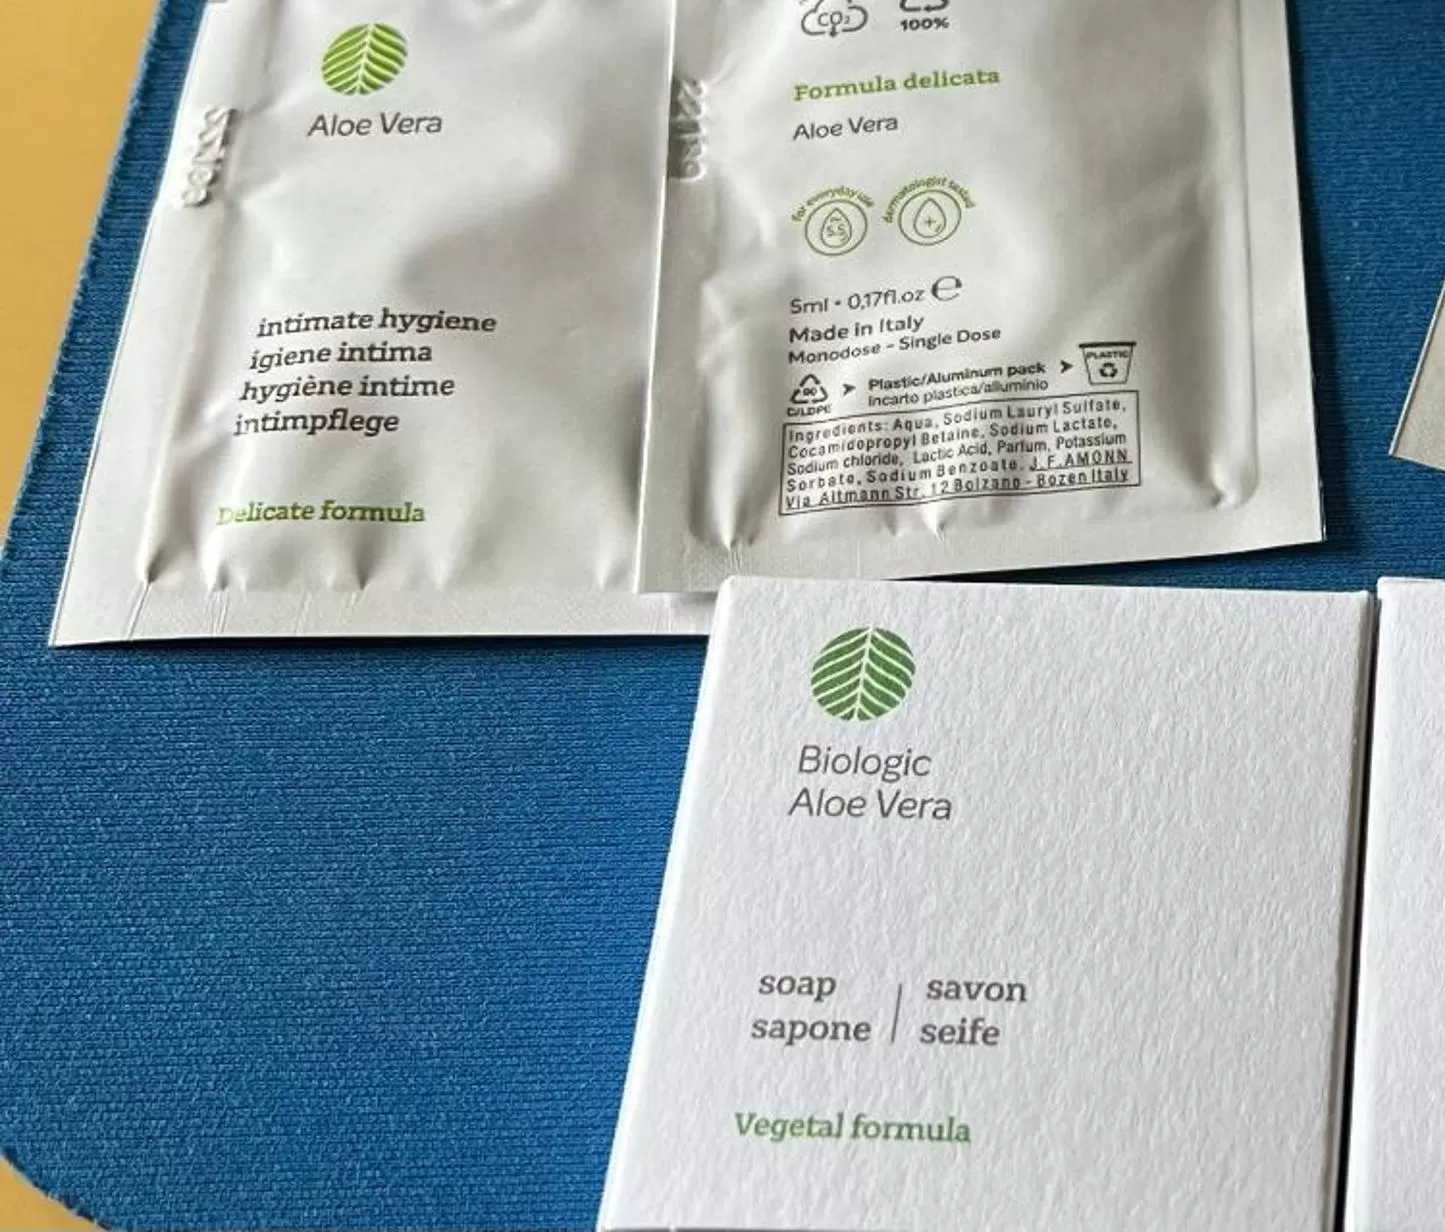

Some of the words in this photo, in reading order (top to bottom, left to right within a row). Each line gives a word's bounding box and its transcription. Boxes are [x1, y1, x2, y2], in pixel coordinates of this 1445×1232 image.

[900, 16, 950, 32] 100%
[792, 74, 897, 102] Formula
[903, 68, 1001, 92] delicata
[307, 114, 374, 138] Aloe
[379, 111, 443, 135] Vera
[792, 122, 843, 142] Aloe
[848, 115, 899, 135] Vera
[789, 298, 828, 315] 5ml
[256, 311, 374, 338] intimate
[376, 308, 497, 334] hygiene
[788, 327, 849, 345] Made
[854, 322, 873, 337] in
[879, 315, 925, 335] Italy
[249, 345, 331, 374] igiene
[336, 341, 433, 363] intima
[788, 342, 881, 365] Monodose
[899, 332, 952, 352] Single
[956, 327, 1001, 343] Dose
[239, 374, 353, 405] hygiène
[357, 376, 456, 398] intime
[868, 366, 1004, 392] Plastic/Aluminum
[1007, 362, 1046, 377] pack
[924, 378, 1049, 405] plastica/alluminio
[234, 408, 400, 437] intimpflege
[943, 406, 1003, 426] Sodium
[1007, 404, 1059, 419] Lauryl
[787, 459, 839, 476] Sodium
[913, 448, 954, 465] Lactic
[1056, 433, 1126, 450] Potassium
[788, 434, 916, 458] Cocamidopropyl
[989, 422, 1049, 437] Sodium
[866, 468, 931, 484] Sodium
[1092, 467, 1128, 484] Italy
[216, 502, 317, 526] Delicate
[319, 499, 426, 524] formula
[798, 745, 932, 784] Biologic
[788, 788, 867, 818] Aloe
[876, 789, 953, 822] Vera
[758, 973, 837, 1002] soap
[925, 977, 1028, 1003] savon
[751, 1017, 872, 1047] sapone
[918, 1017, 1001, 1047] seife
[734, 1111, 845, 1142] Vegetal
[851, 1114, 973, 1143] formula
